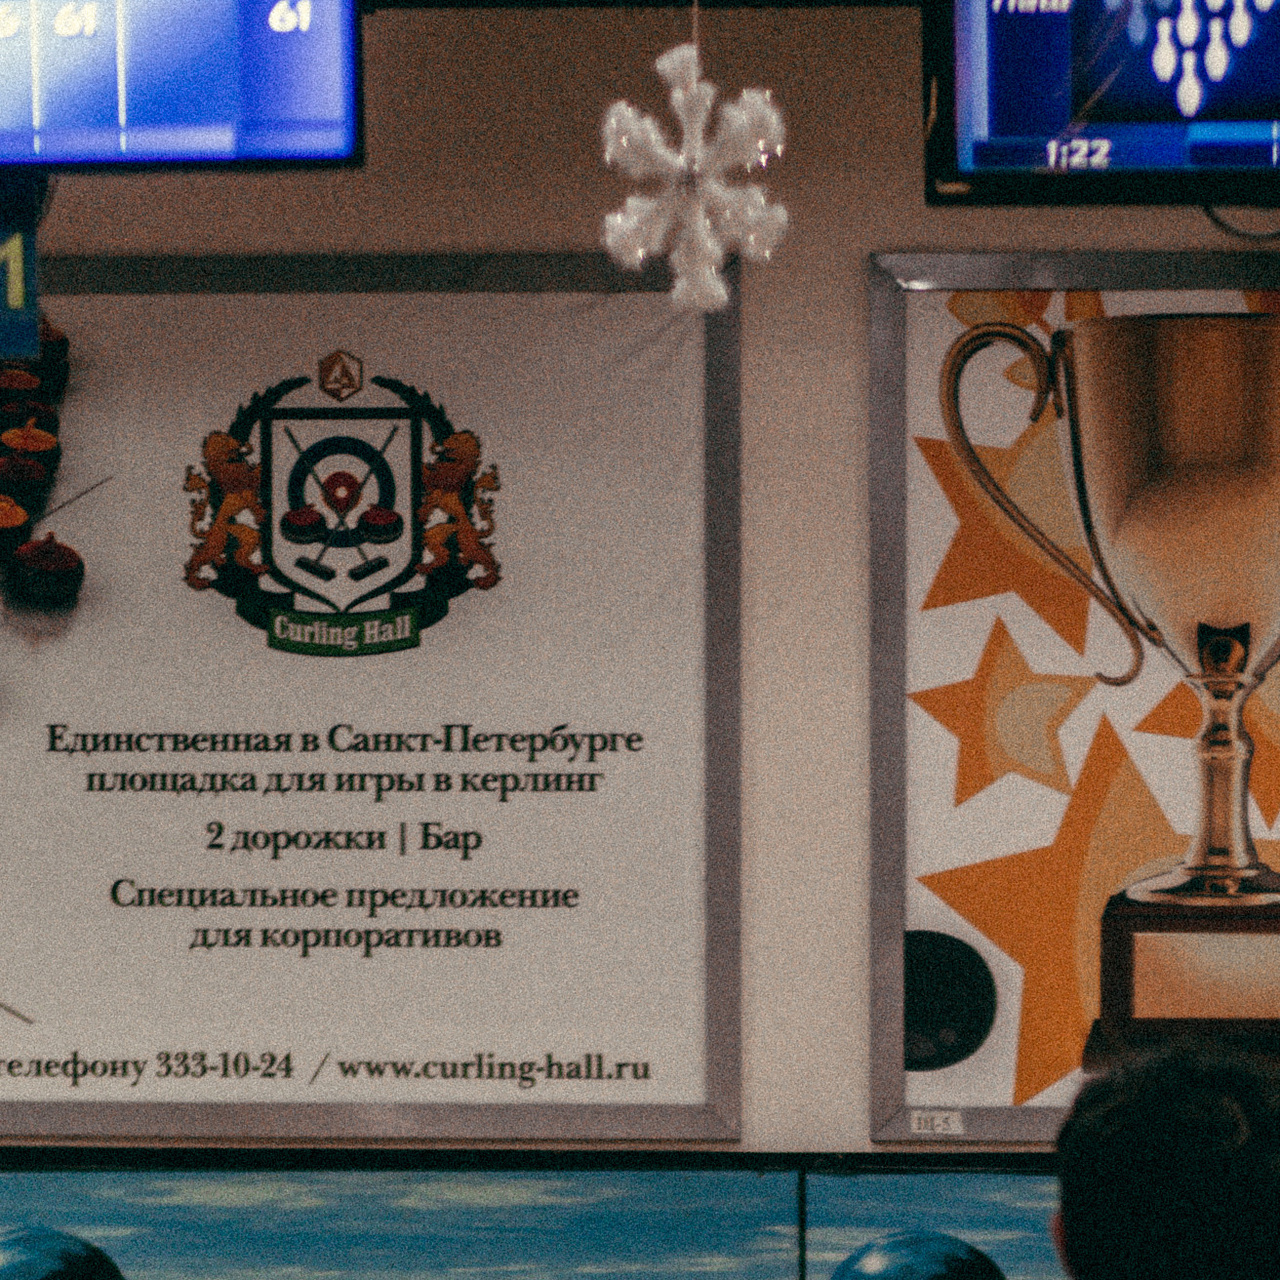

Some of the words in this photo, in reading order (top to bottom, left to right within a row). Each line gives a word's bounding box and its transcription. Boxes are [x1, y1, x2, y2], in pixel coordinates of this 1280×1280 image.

[52, 1, 97, 37] 61
[267, 0, 311, 32] 61
[1046, 138, 1112, 170] 1:22
[275, 606, 358, 650] Curling
[363, 605, 411, 644] Hall
[46, 722, 294, 756] Единственная
[299, 731, 322, 754] в
[325, 722, 645, 765] Санкт-Петербурге
[85, 771, 259, 796] площадка
[261, 771, 328, 796] для
[333, 771, 426, 804] игры
[432, 771, 454, 794] в
[459, 771, 603, 804] керлинг
[205, 820, 226, 852] 2
[229, 829, 388, 862] дорожки
[419, 820, 484, 862] Бар
[108, 877, 339, 911] Специальное
[344, 887, 581, 920] предложение
[188, 926, 254, 951] для
[259, 926, 504, 960] корпоративов
[155, 1050, 295, 1080] 333-10-24
[336, 1051, 652, 1089] www.curling-hall.ru
